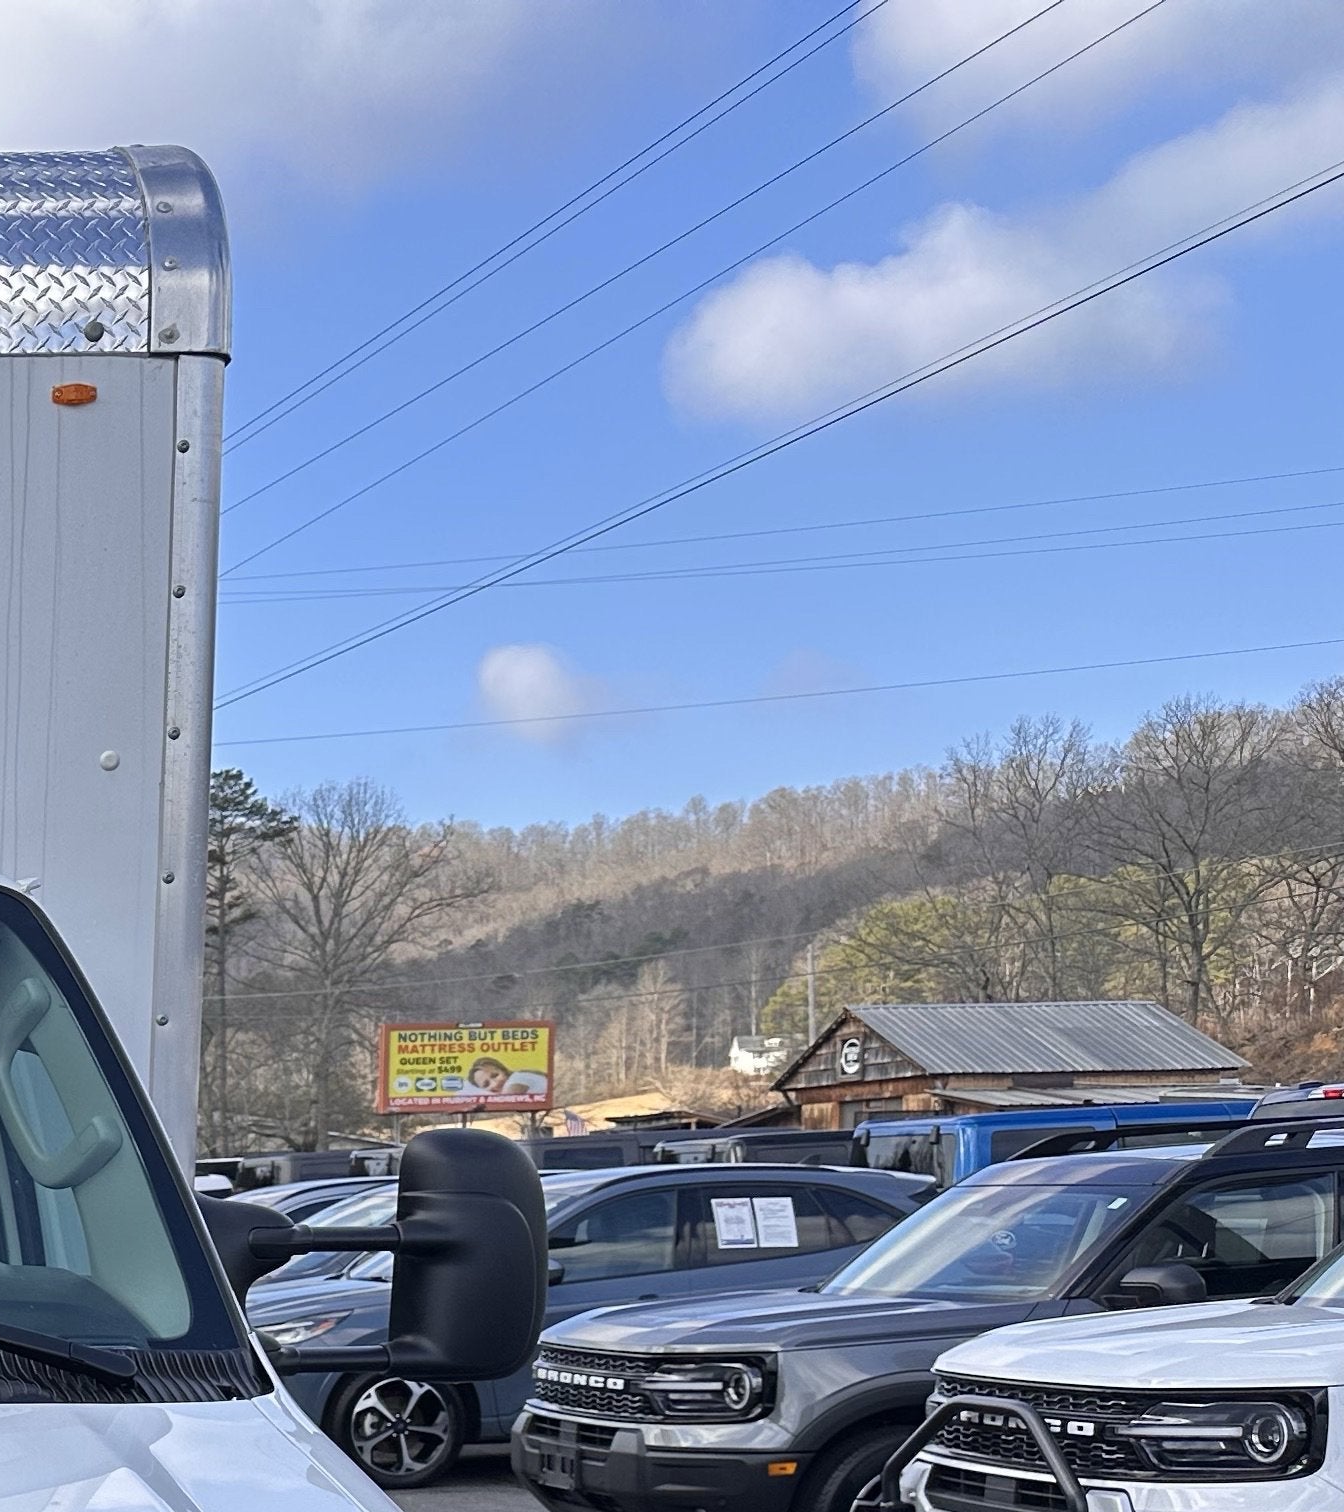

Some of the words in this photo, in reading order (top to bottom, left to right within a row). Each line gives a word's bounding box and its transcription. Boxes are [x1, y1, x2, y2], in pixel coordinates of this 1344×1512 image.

[397, 1031, 464, 1043] NOTHING
[468, 1030, 497, 1041] BUT
[501, 1029, 539, 1041] BEDS
[397, 1042, 476, 1055] MATTRESS
[480, 1041, 538, 1053] OUTLET
[399, 1057, 436, 1066] QUEEN
[438, 1056, 459, 1065] SET
[437, 1065, 462, 1074] $499
[537, 1368, 625, 1390] BRONCO
